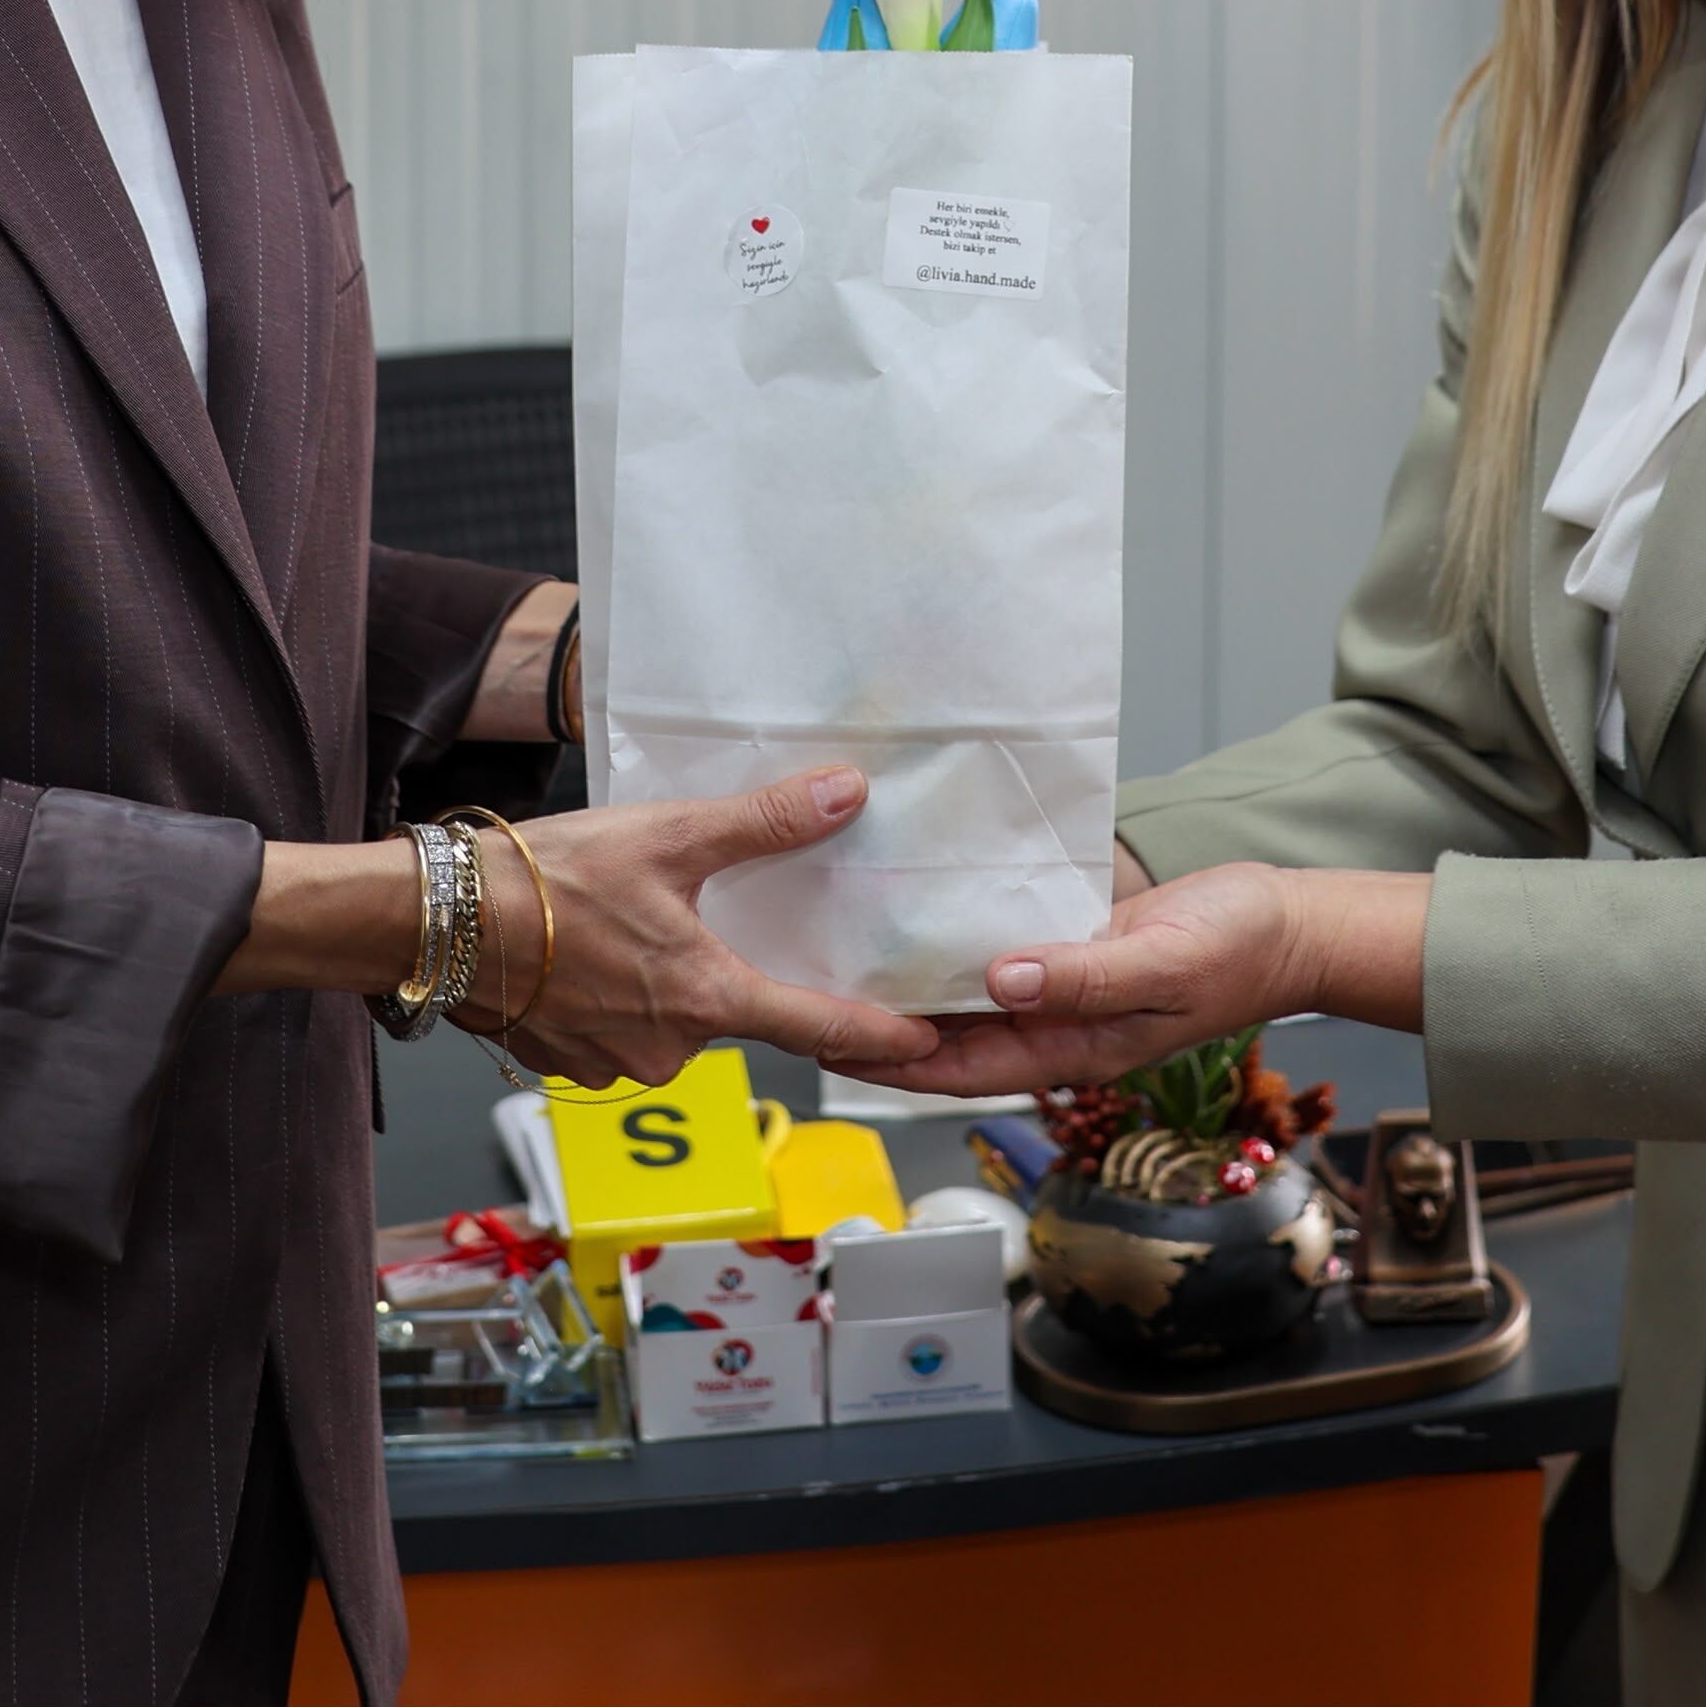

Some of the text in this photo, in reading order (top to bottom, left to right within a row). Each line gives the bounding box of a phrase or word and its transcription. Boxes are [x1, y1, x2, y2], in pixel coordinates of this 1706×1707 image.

[937, 200, 1010, 218] Her biri emekle,
[929, 214, 1001, 230] sevgiyle yapıldı
[920, 225, 1022, 246] Destek olmak istersen,
[943, 240, 997, 256] bizi takip et
[916, 264, 1037, 290] @livia.hand.made
[622, 1104, 692, 1168] S
